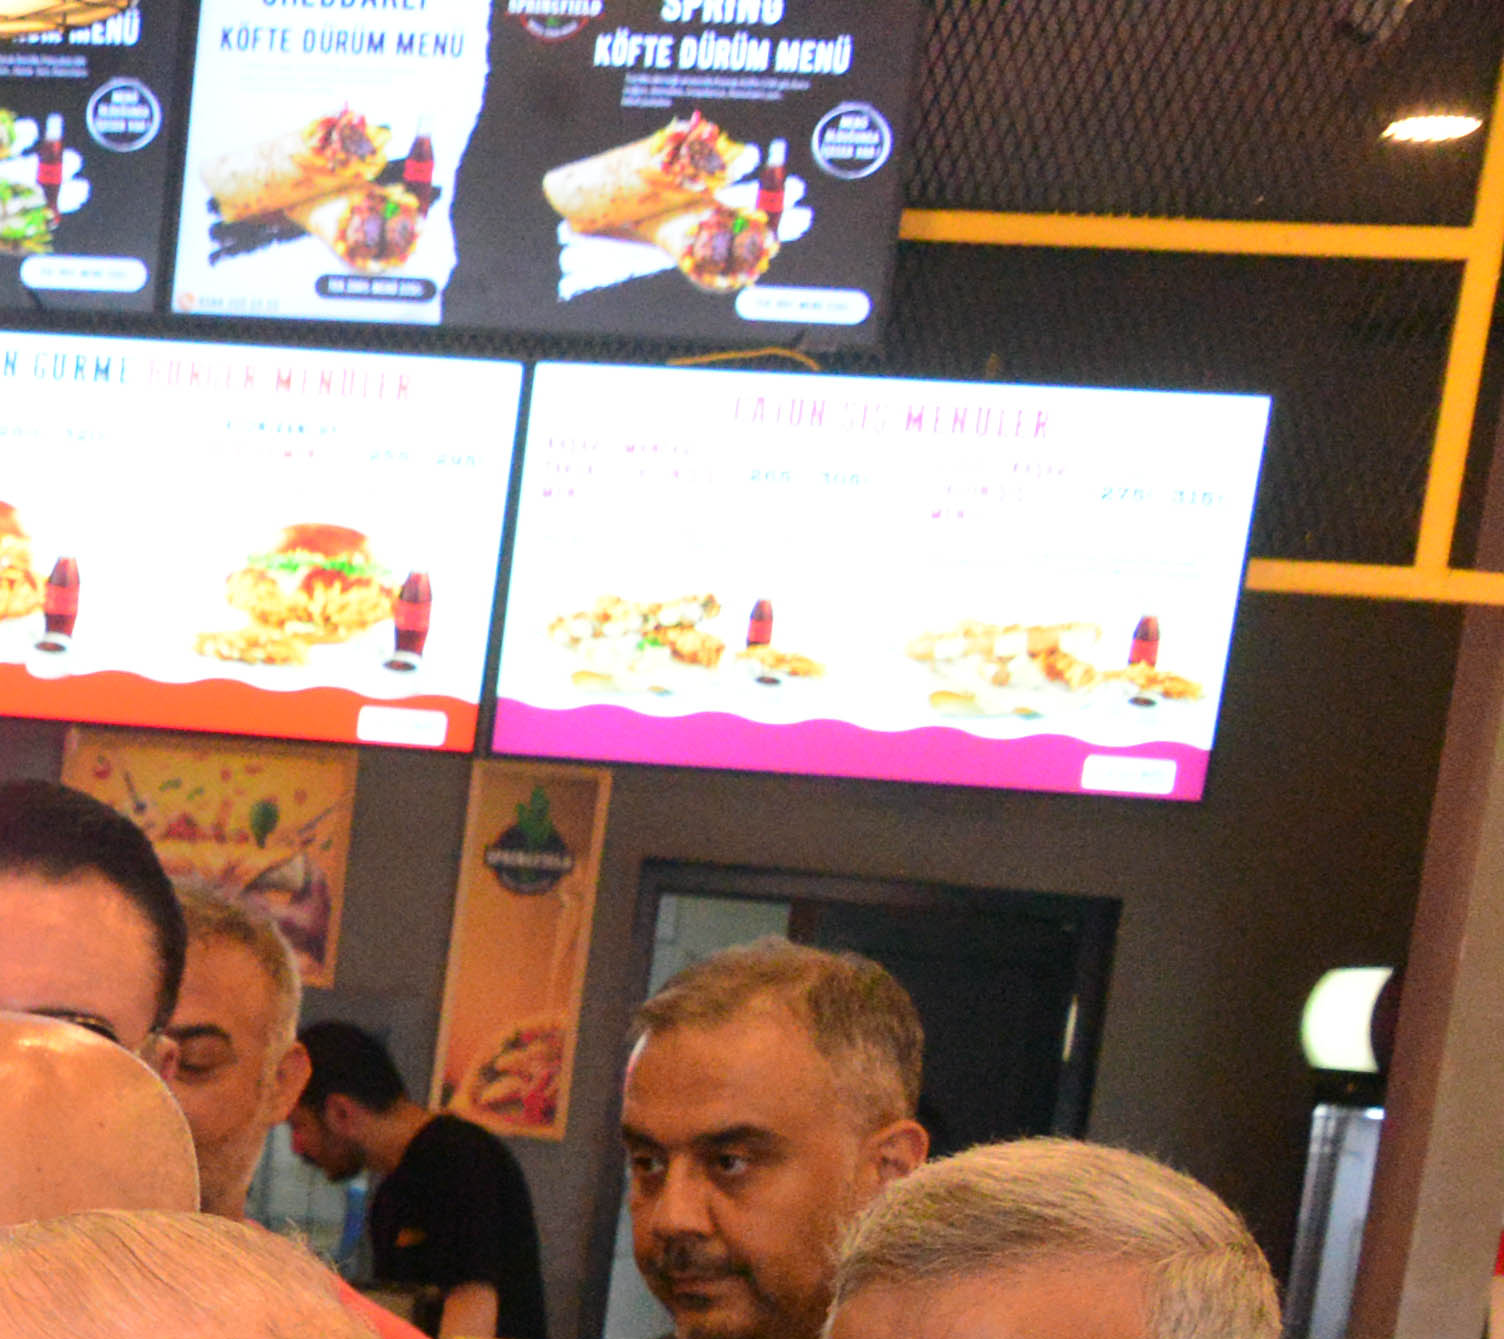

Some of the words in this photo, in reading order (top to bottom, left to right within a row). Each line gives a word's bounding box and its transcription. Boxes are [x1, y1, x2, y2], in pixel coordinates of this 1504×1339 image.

[220, 21, 292, 52] KÖFTE
[302, 22, 386, 55] DÜRÜM
[593, 26, 675, 67] KÖFTE
[678, 29, 773, 72] DÜRÜM
[774, 34, 854, 75] MENÜ
